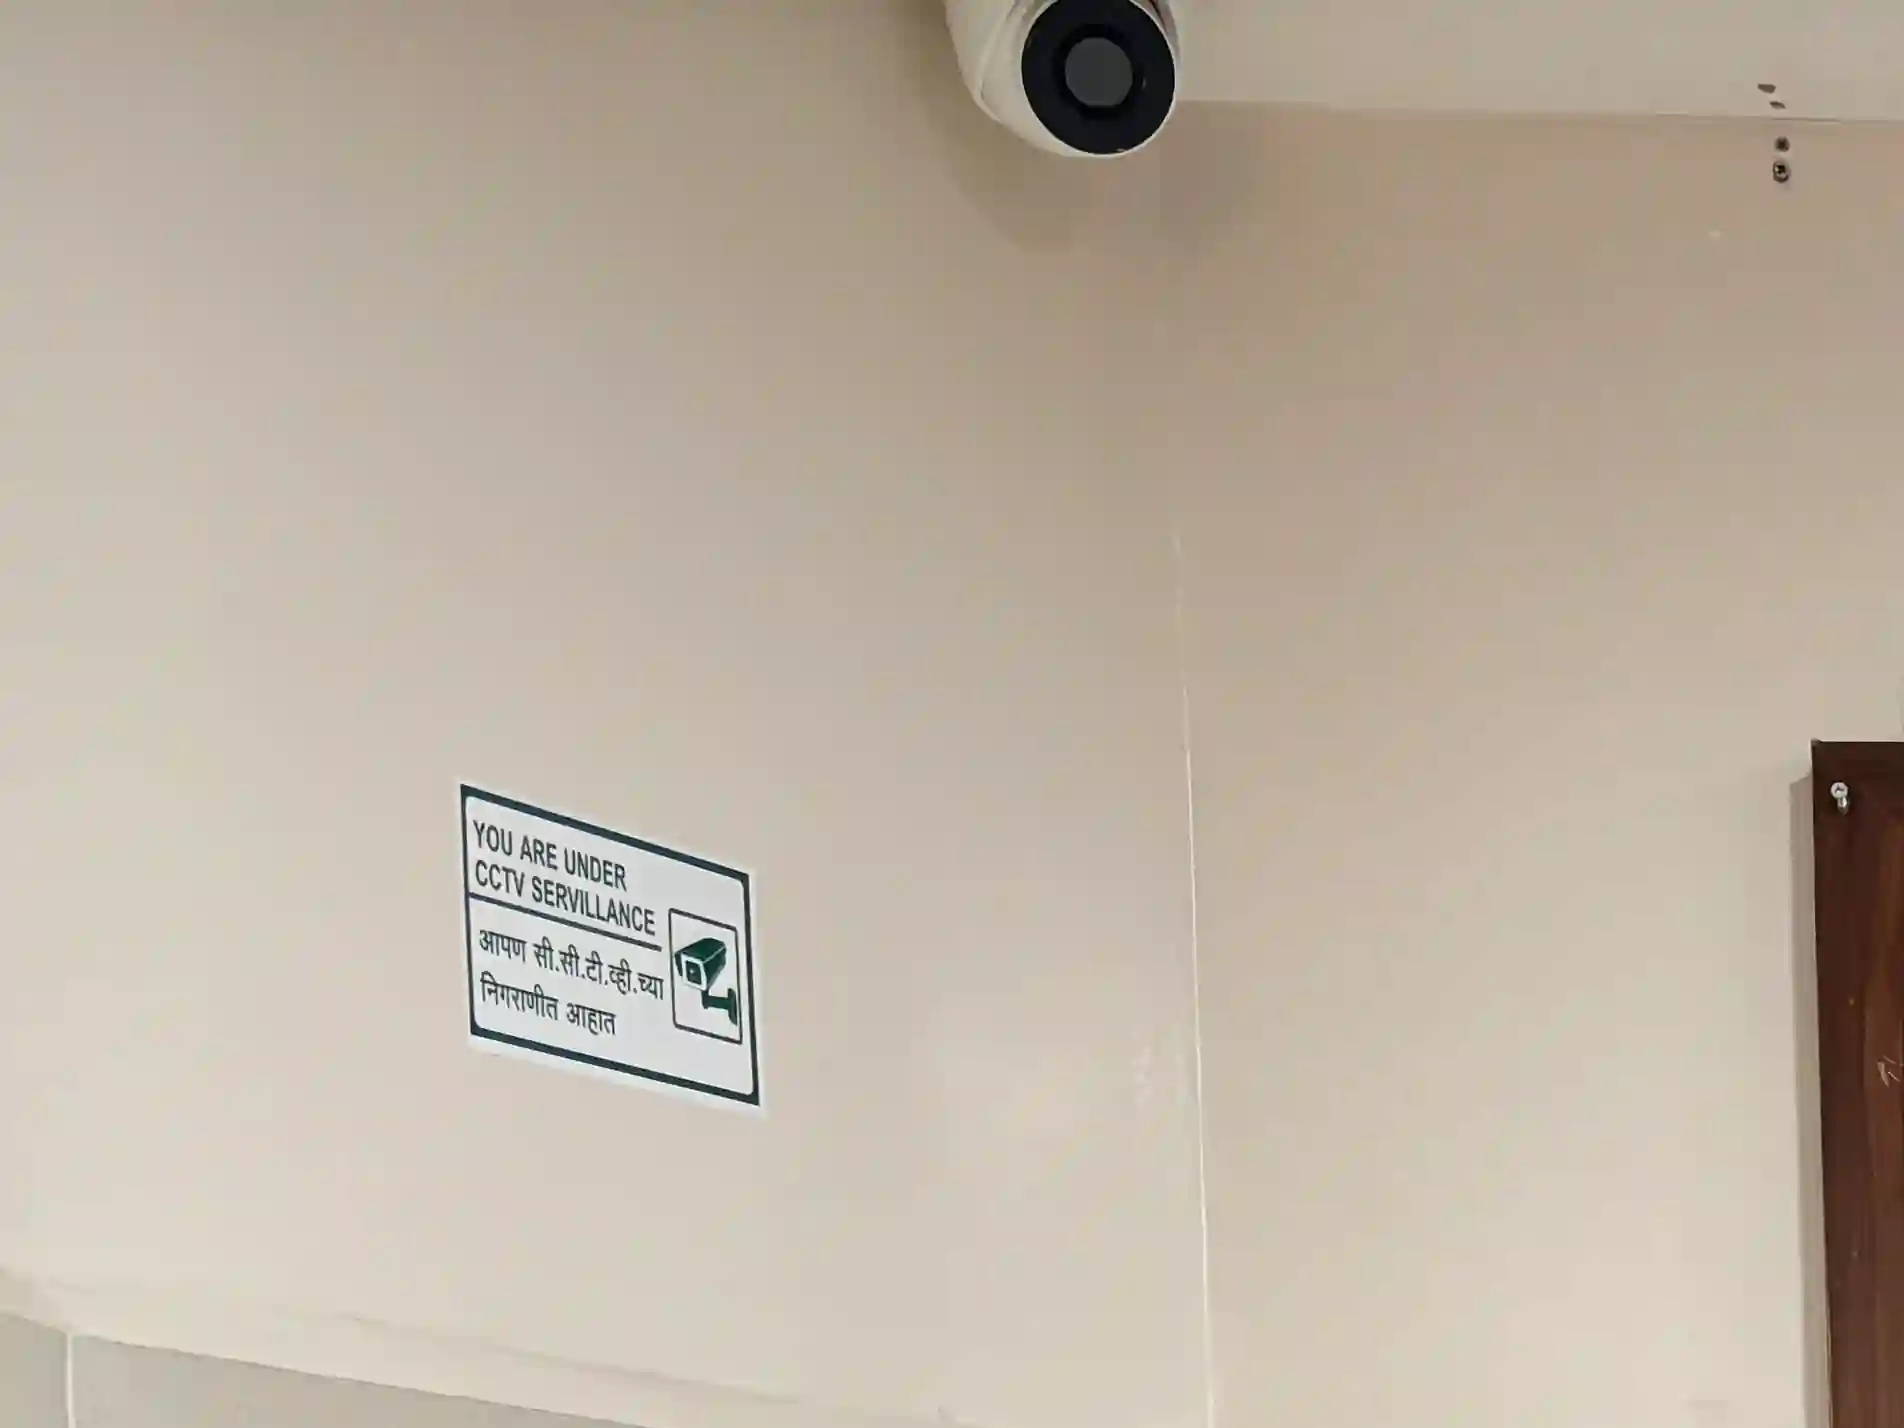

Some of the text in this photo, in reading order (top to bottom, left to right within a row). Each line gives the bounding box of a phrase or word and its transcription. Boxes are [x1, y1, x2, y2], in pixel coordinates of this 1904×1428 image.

[473, 819, 628, 891] YOU ARE UNDER
[476, 860, 656, 936] CCTV SERVILLANCE
[480, 929, 527, 963] आपण
[480, 971, 617, 1036] निगराणीत आहात
